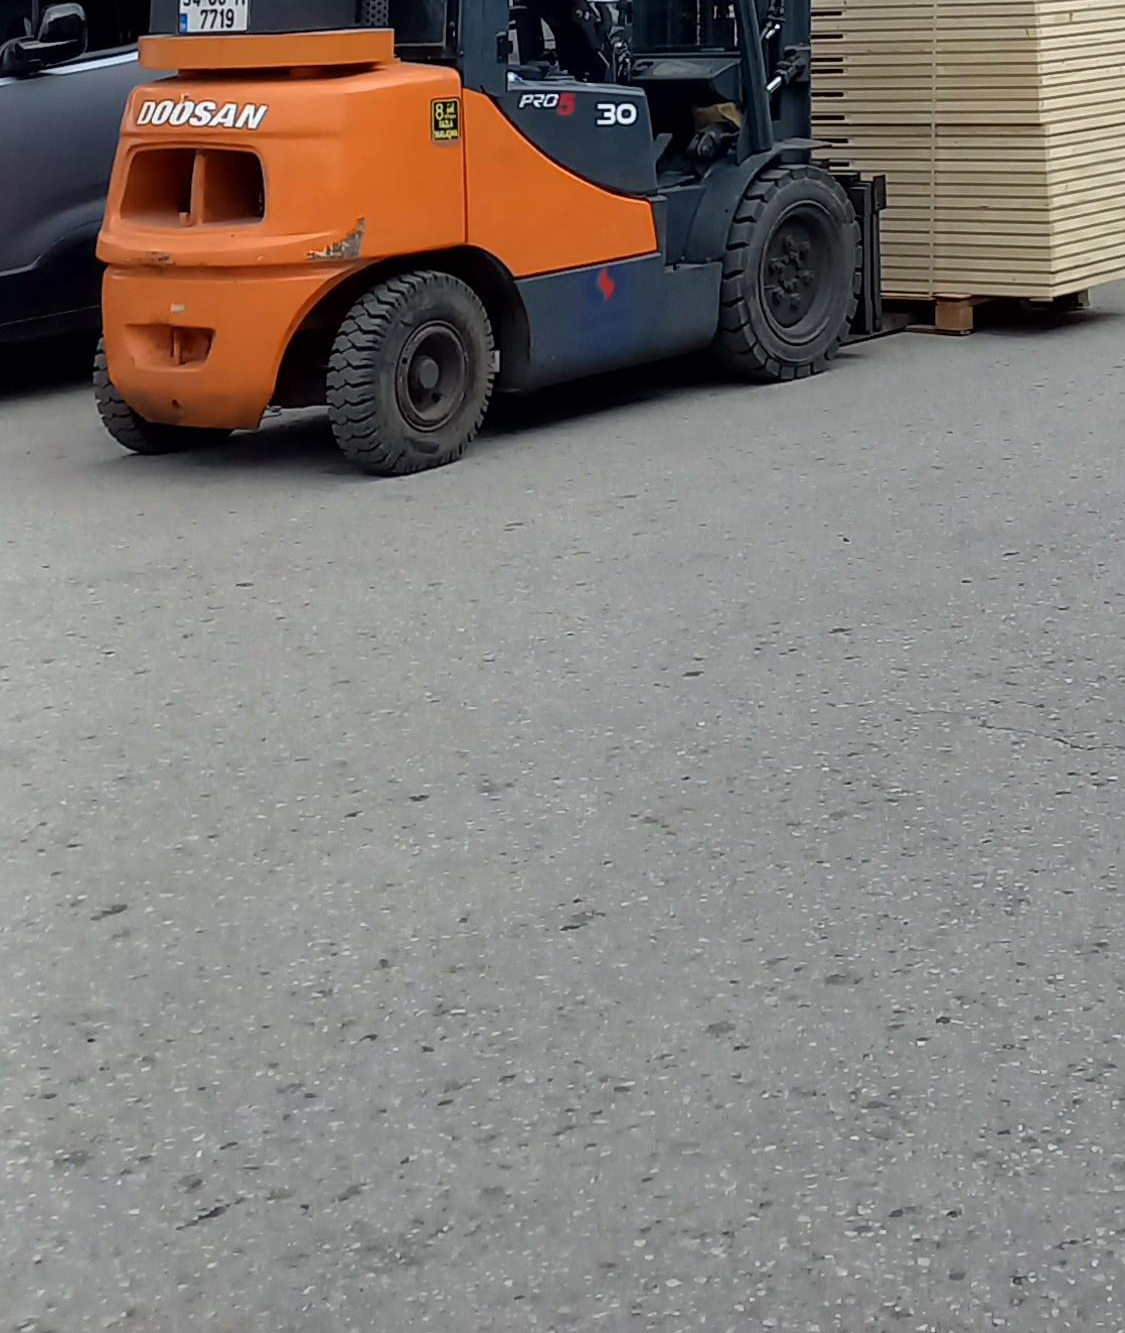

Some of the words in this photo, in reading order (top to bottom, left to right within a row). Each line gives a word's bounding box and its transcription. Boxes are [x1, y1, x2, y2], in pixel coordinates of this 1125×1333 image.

[200, 8, 235, 30] 7719
[136, 99, 268, 130] DOOSAN
[596, 103, 637, 125] 30
